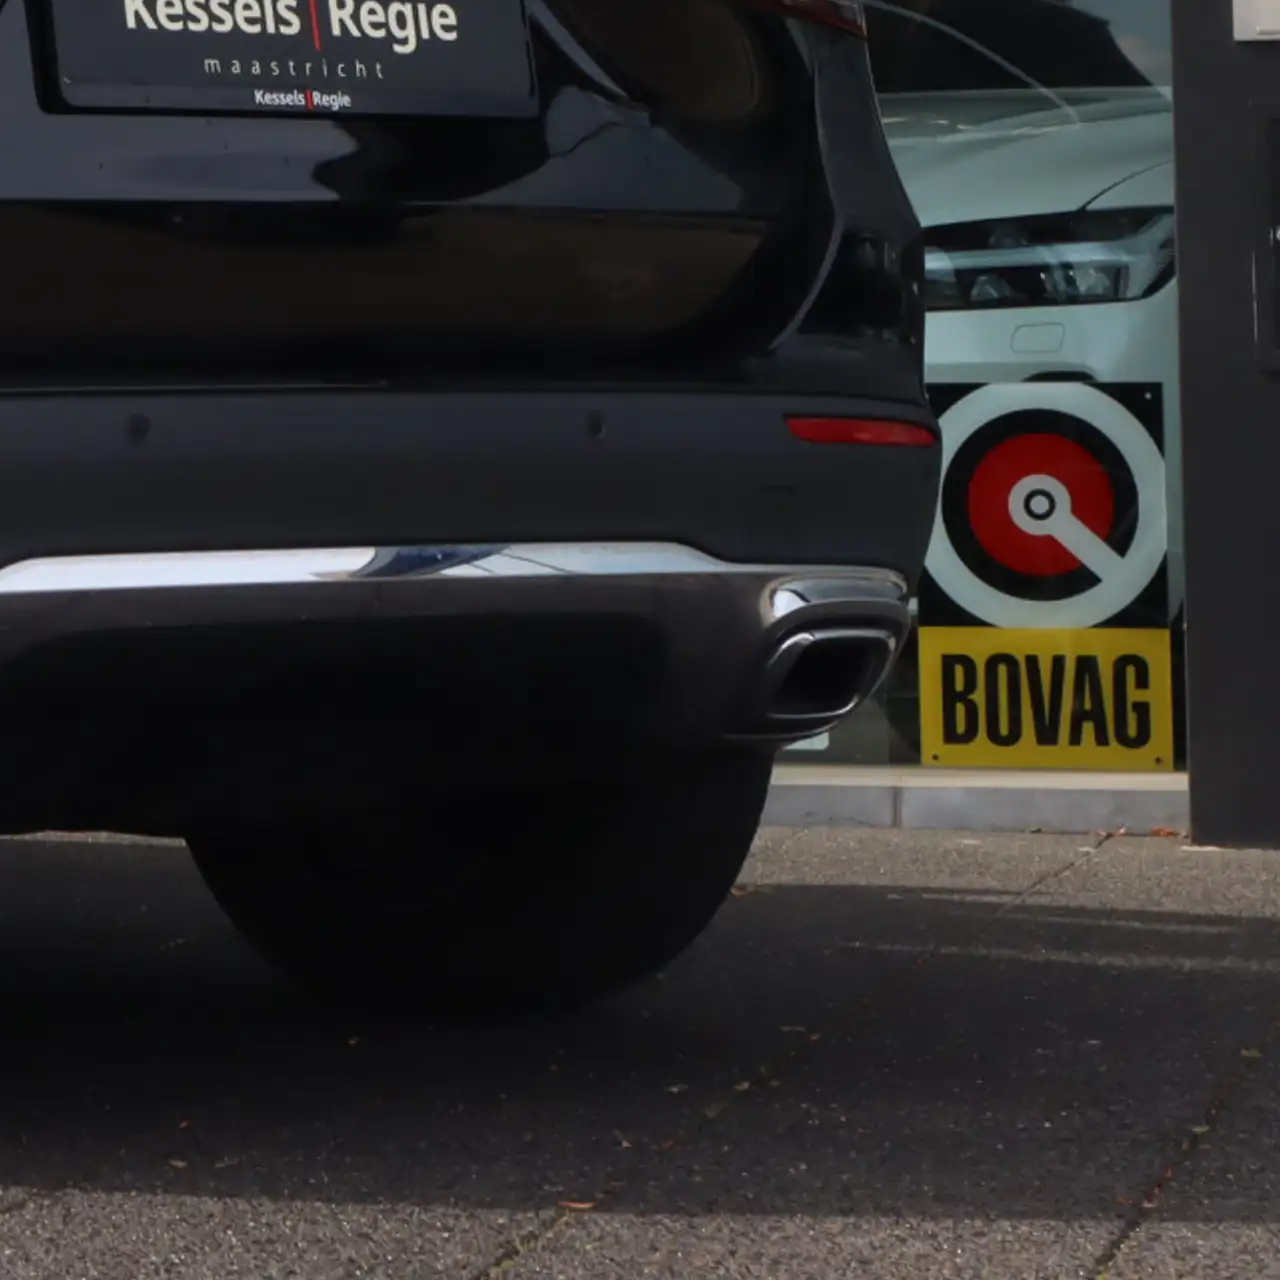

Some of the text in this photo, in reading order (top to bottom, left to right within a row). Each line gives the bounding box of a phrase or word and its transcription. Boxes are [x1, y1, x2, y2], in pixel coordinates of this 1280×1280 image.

[204, 56, 385, 80] maastricht
[253, 89, 353, 112] Kessels Regie
[942, 653, 1152, 748] BOVAG
